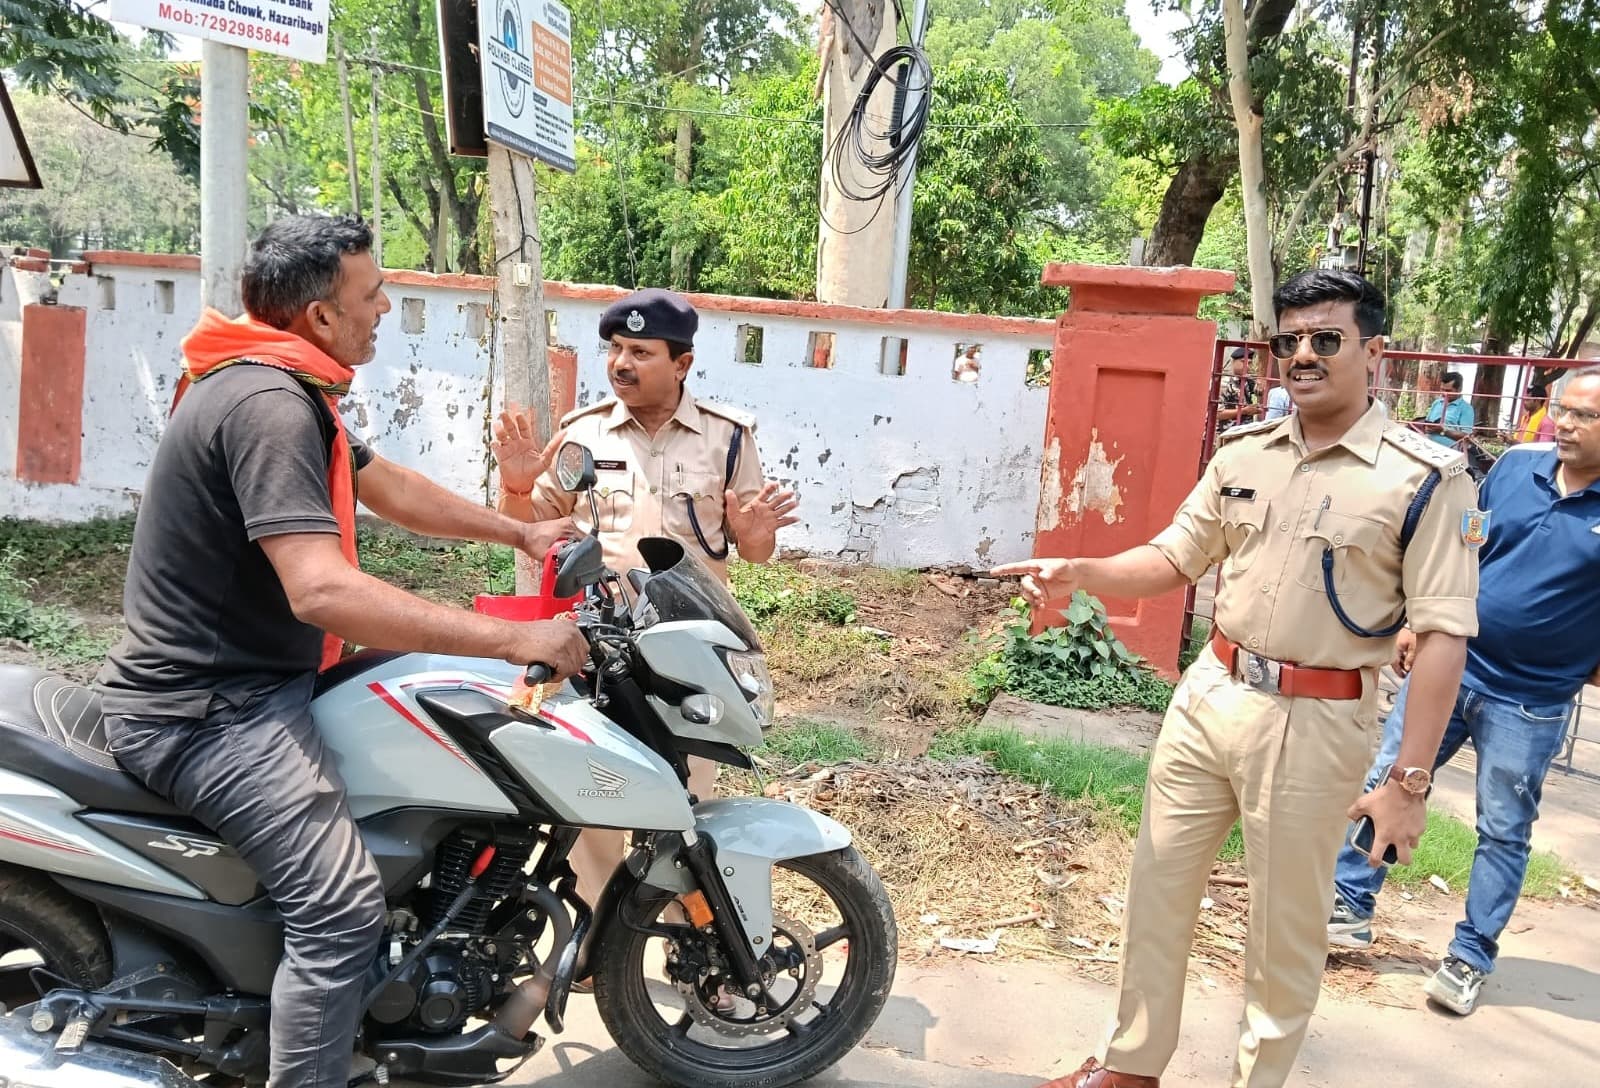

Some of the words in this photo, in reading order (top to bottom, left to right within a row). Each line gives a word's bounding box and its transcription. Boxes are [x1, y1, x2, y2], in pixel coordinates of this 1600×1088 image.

[158, 3, 291, 47] Mob:7292985844
[227, 0, 266, 21] Chowk,
[269, 9, 323, 35] Hazaribagh
[511, 56, 533, 79] CLASSES
[577, 789, 625, 799] HONDA
[147, 834, 227, 858] SP
